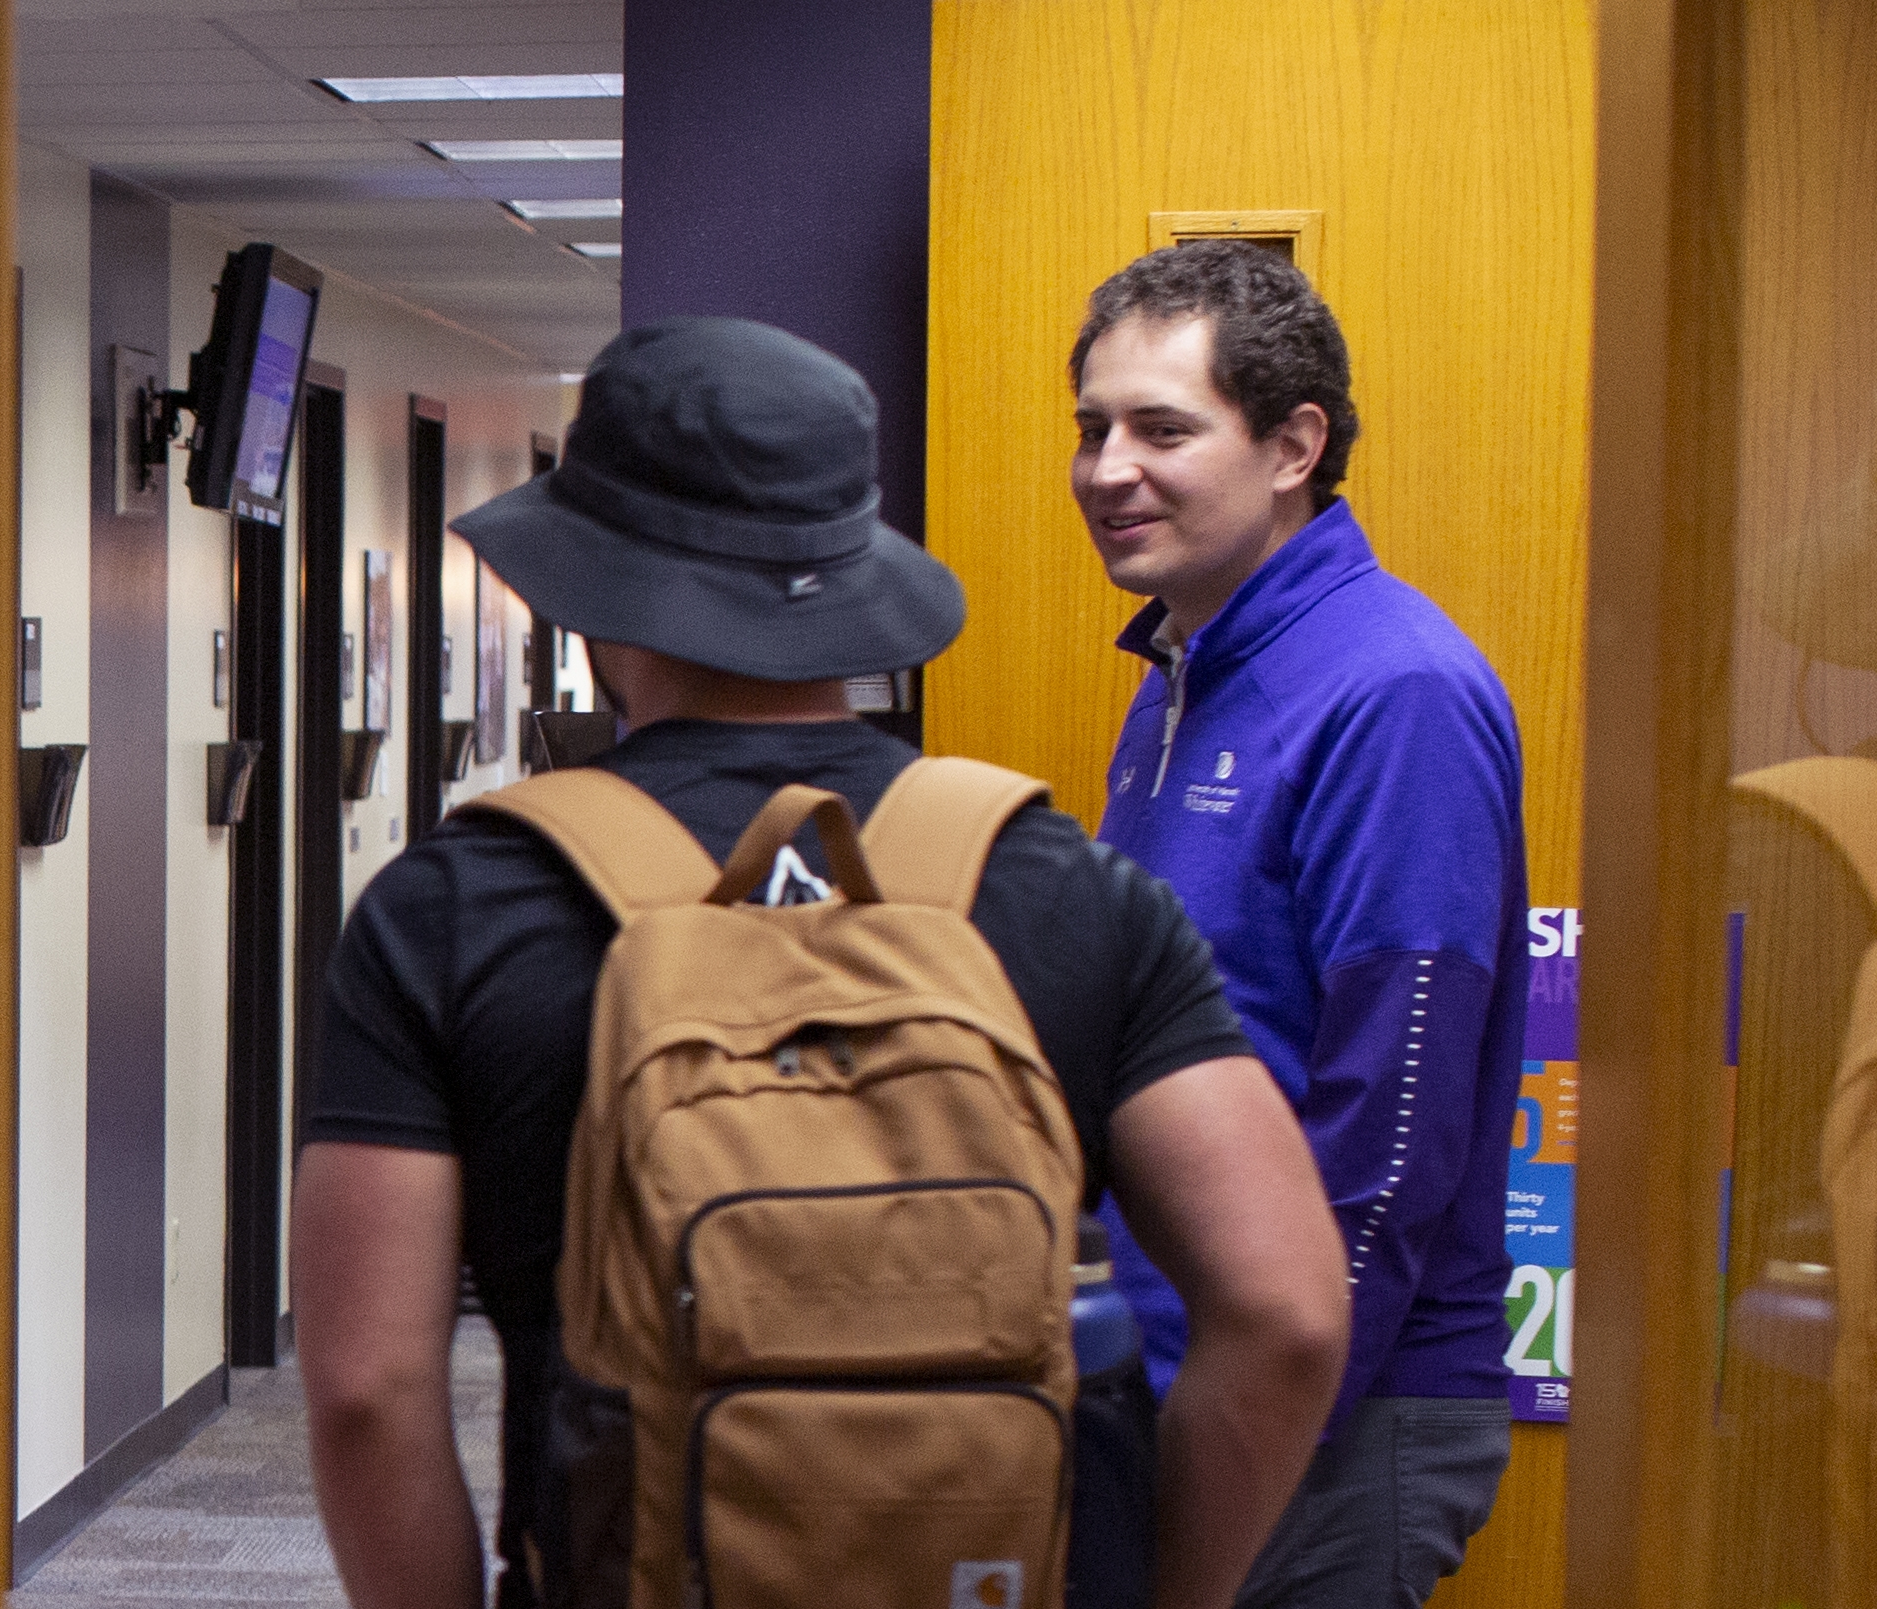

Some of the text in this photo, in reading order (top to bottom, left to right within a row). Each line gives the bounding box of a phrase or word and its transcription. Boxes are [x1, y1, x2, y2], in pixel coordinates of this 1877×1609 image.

[1506, 1191, 1546, 1206] Thirty
[1505, 1207, 1538, 1218] units
[1505, 1224, 1560, 1236] per year
